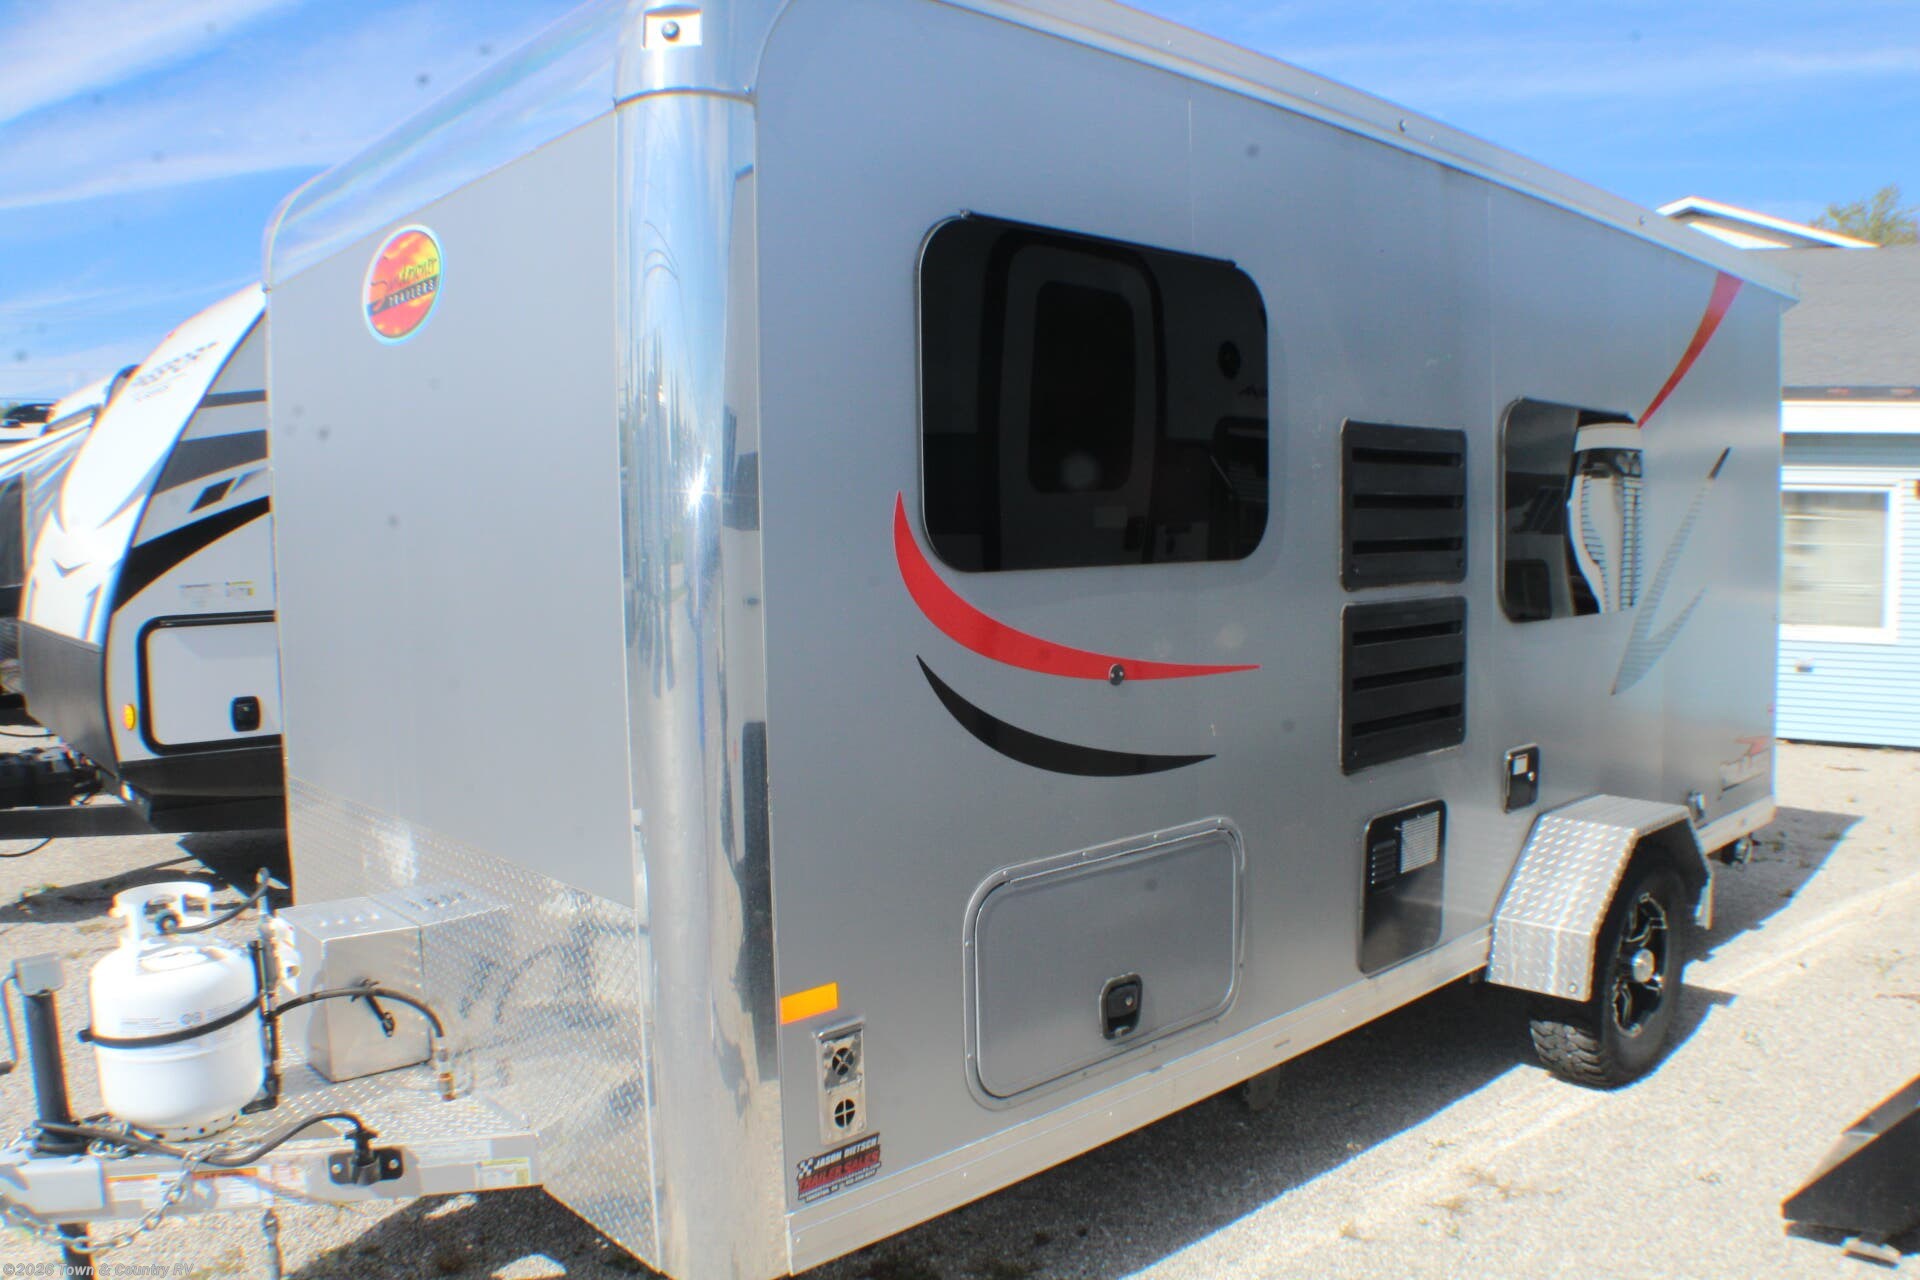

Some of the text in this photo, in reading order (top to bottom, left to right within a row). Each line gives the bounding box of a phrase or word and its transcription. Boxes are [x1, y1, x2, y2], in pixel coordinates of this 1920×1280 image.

[388, 279, 434, 306] TRAILERS
[799, 1166, 842, 1192] TRAILER
[844, 1150, 880, 1174] SALES
[813, 1150, 842, 1169] JASON
